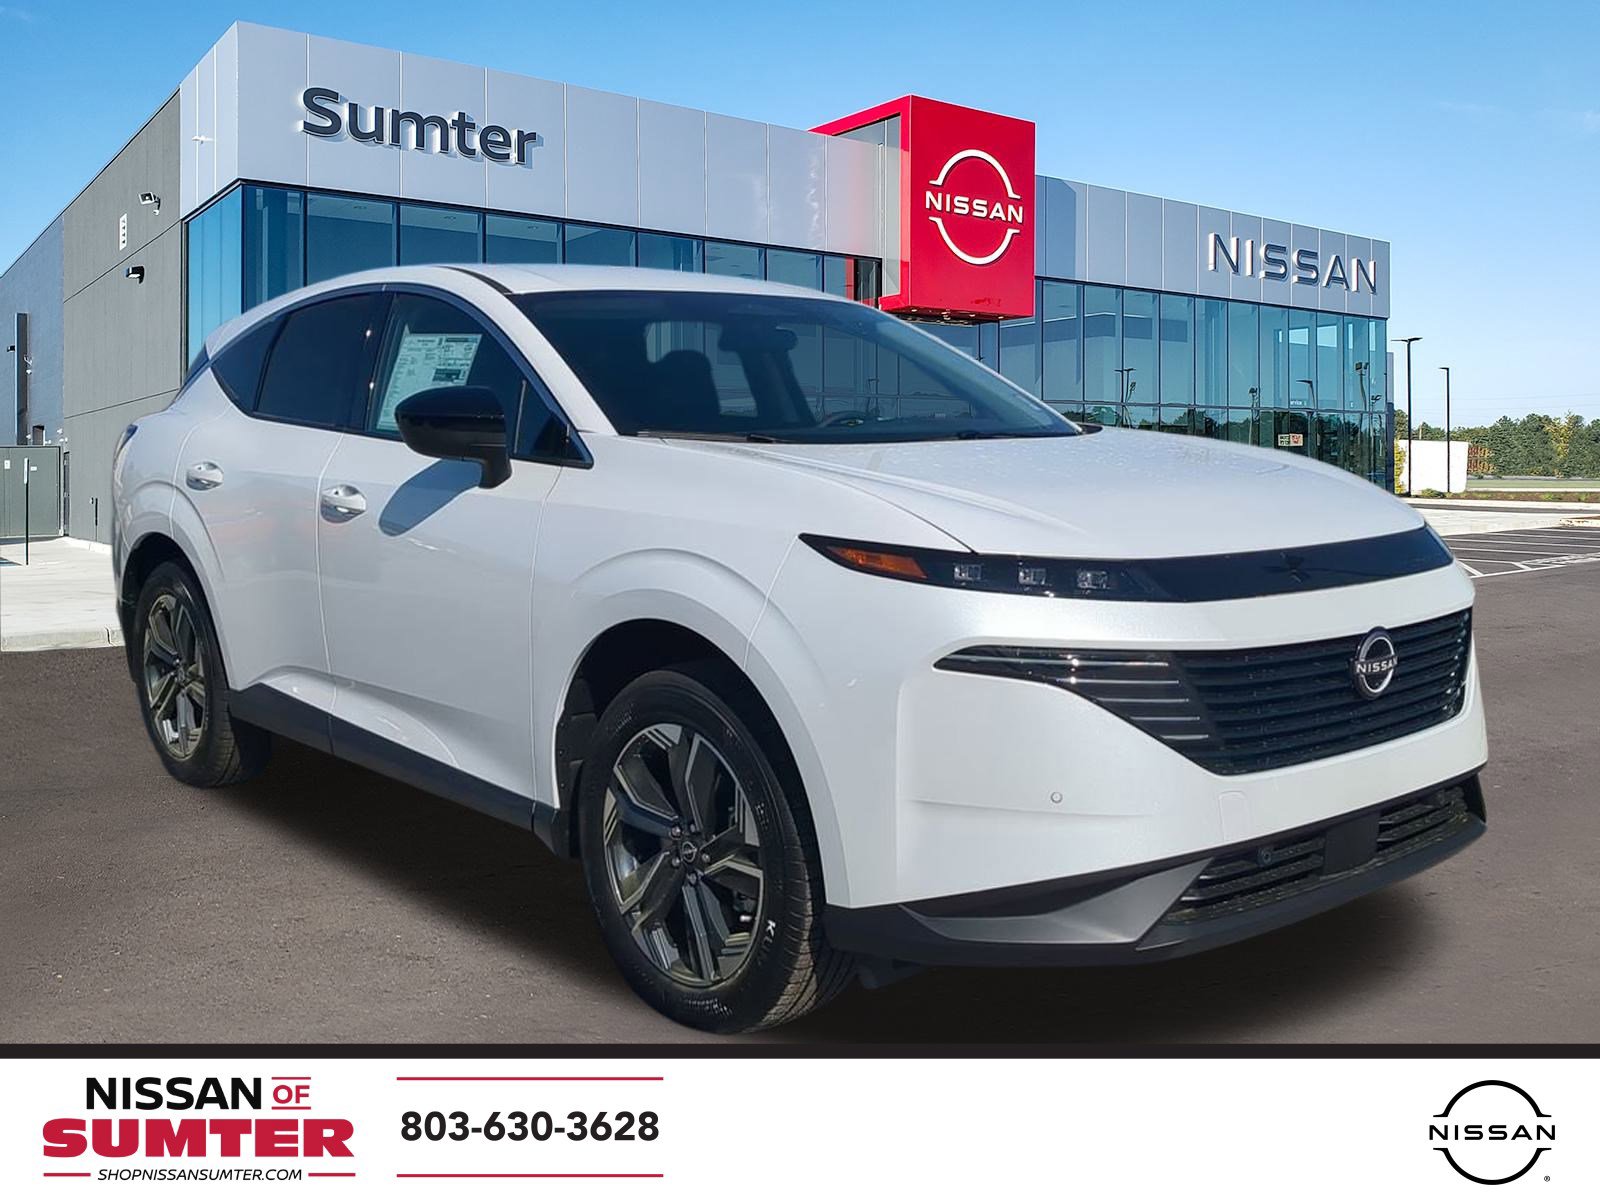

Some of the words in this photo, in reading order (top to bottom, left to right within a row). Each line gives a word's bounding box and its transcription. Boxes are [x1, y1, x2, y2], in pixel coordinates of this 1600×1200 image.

[302, 87, 539, 164] Sumter
[925, 190, 1023, 224] NISSAN
[1208, 232, 1376, 294] NISSAN
